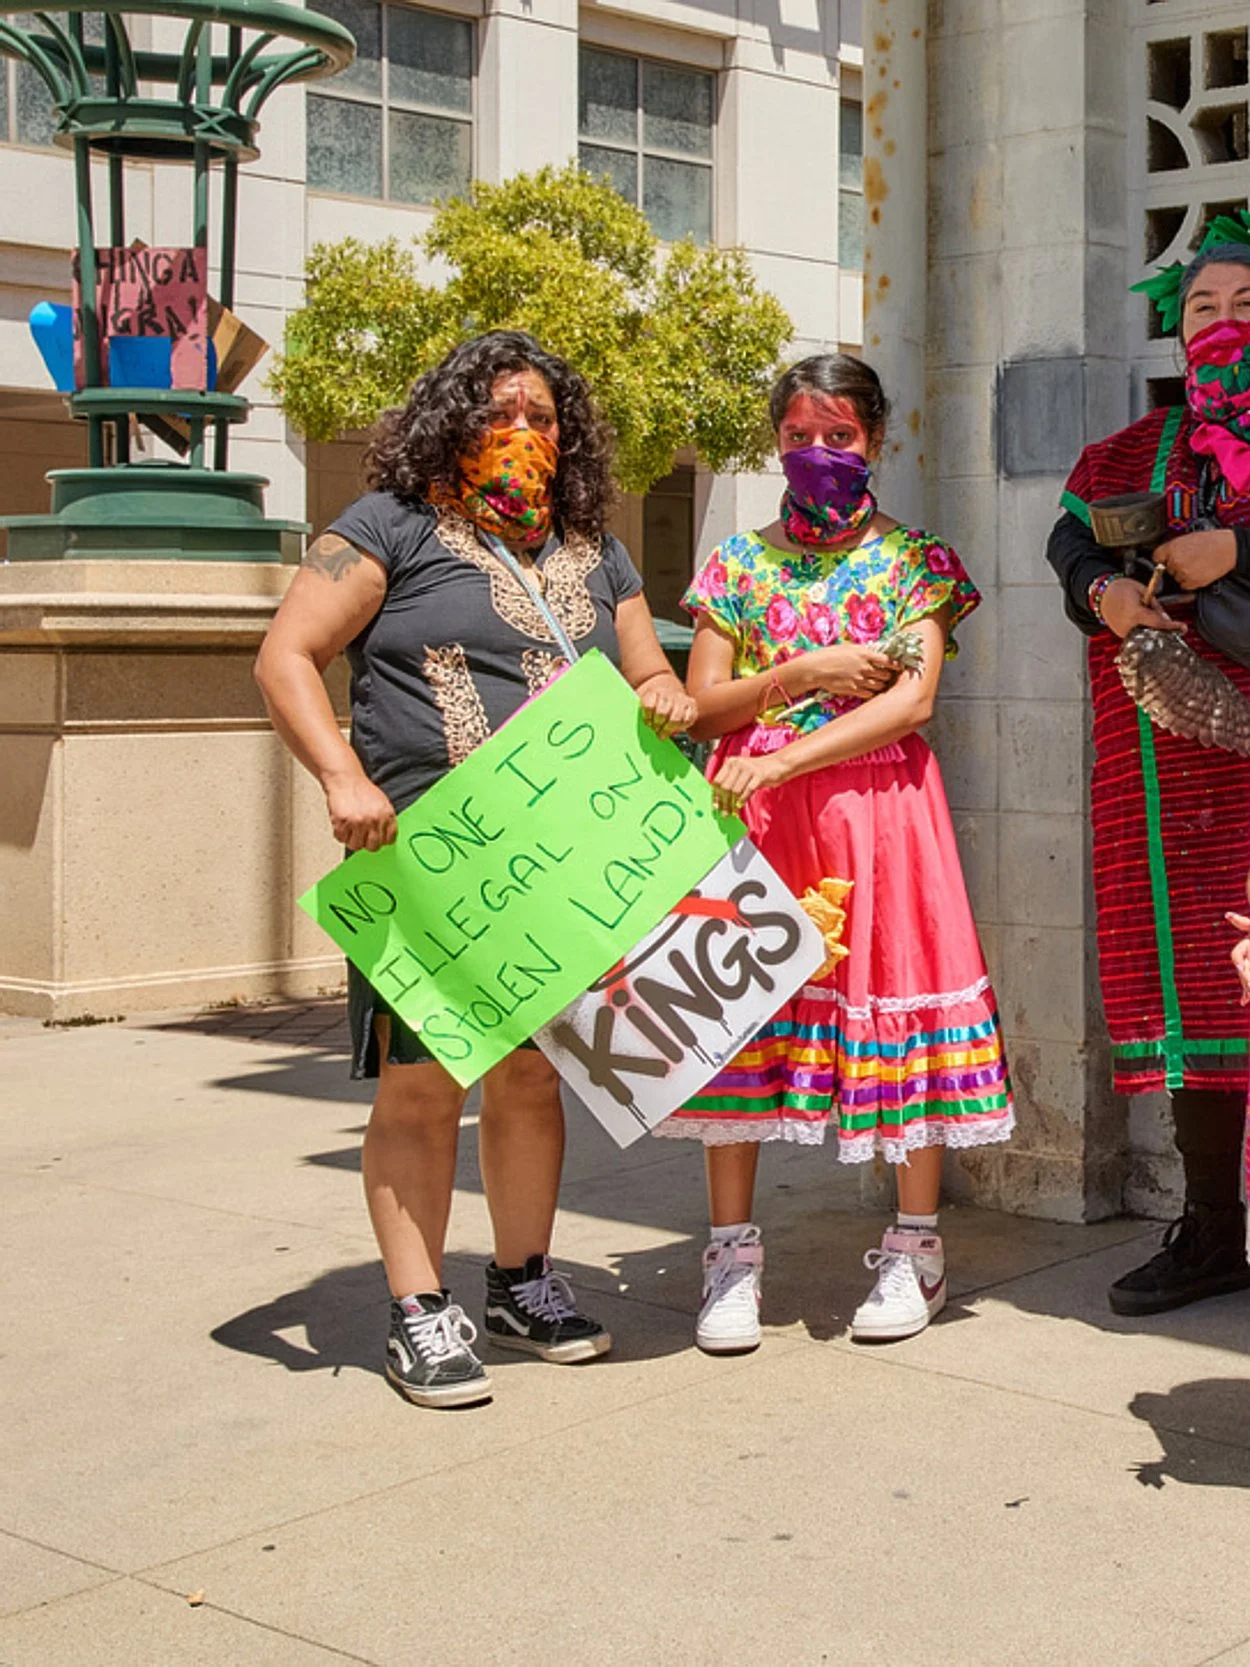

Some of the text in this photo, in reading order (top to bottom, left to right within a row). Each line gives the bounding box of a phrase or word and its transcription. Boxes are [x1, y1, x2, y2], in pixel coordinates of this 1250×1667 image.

[74, 297, 200, 341] IGRA!
[329, 720, 595, 934] NO ONE IS
[377, 752, 643, 1004] ILLEGAL ON
[568, 784, 705, 930] LAND!
